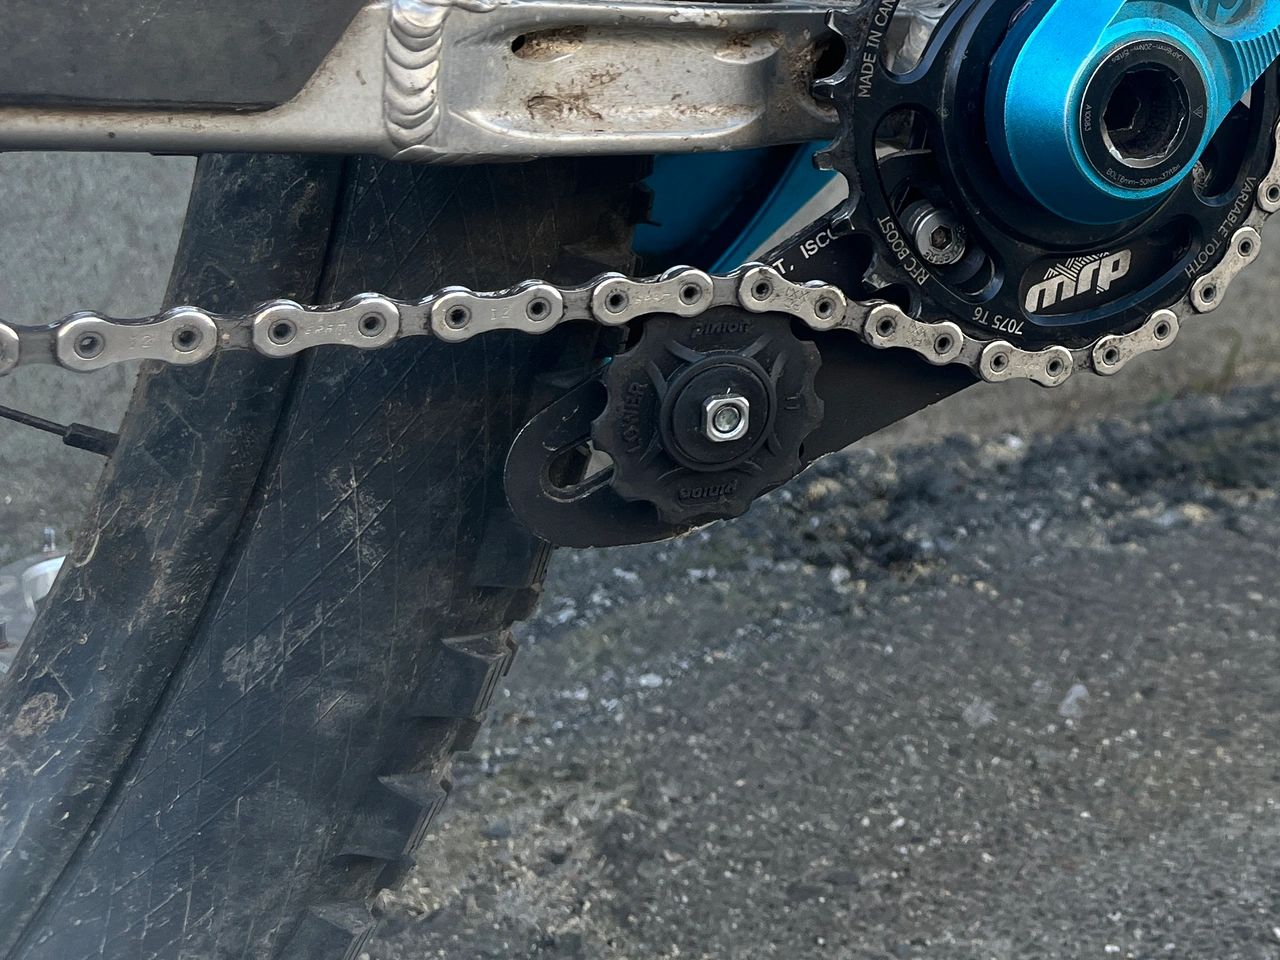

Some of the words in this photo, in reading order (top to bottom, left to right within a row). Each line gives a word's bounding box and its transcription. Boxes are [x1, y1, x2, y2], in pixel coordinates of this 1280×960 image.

[866, 30, 883, 49] IN
[858, 52, 877, 98] MADE
[1217, 176, 1257, 238] VARIABLE
[877, 215, 910, 261] BOOST
[1184, 238, 1223, 279] TOOTH
[903, 259, 930, 287] RFC
[1024, 248, 1132, 314] mrp
[972, 306, 991, 326] T6
[992, 315, 1026, 335] 7075
